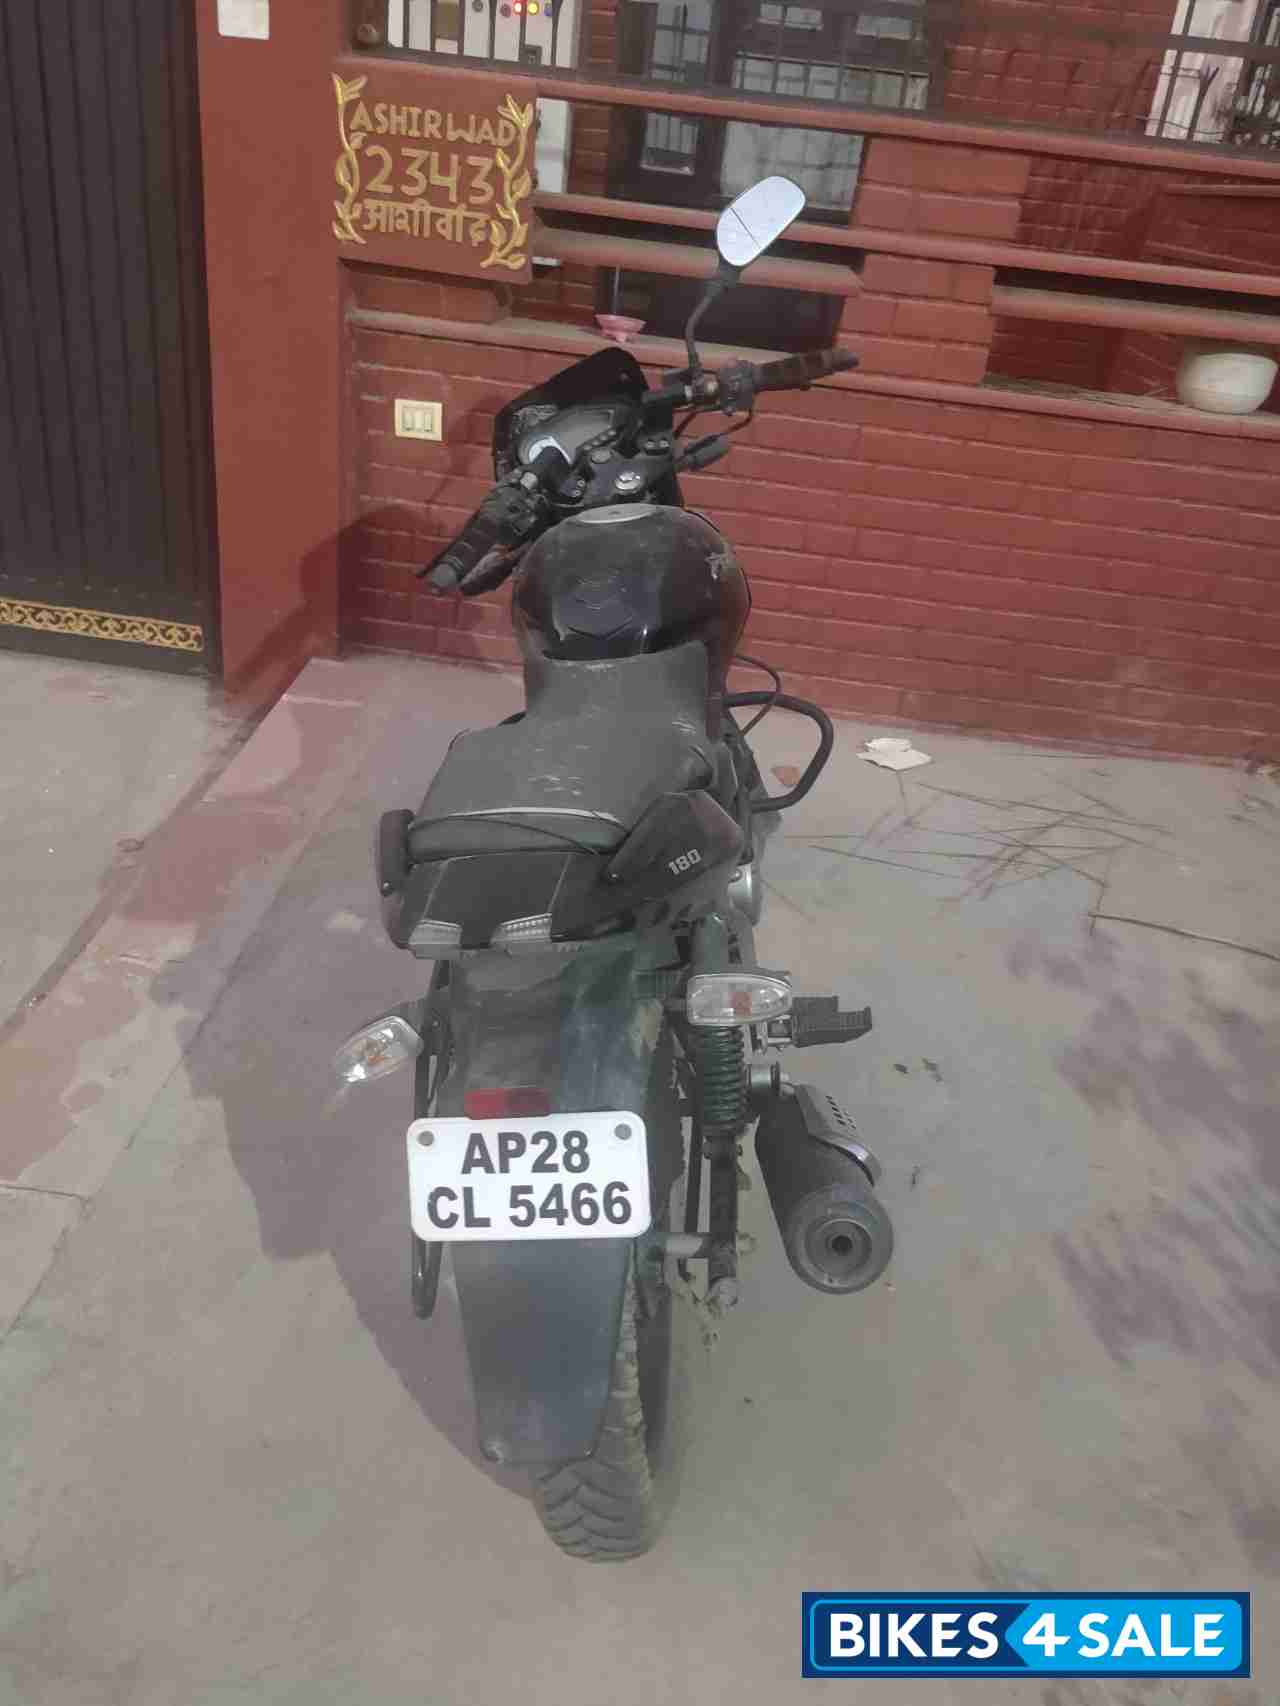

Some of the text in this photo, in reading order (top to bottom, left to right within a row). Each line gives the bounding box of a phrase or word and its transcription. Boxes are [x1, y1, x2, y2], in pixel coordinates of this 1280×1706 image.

[350, 101, 516, 146] ASHIRWAD
[365, 145, 494, 204] 2343
[668, 849, 701, 875] 180
[461, 1130, 590, 1174] AP28
[427, 1181, 632, 1228] CL 5466
